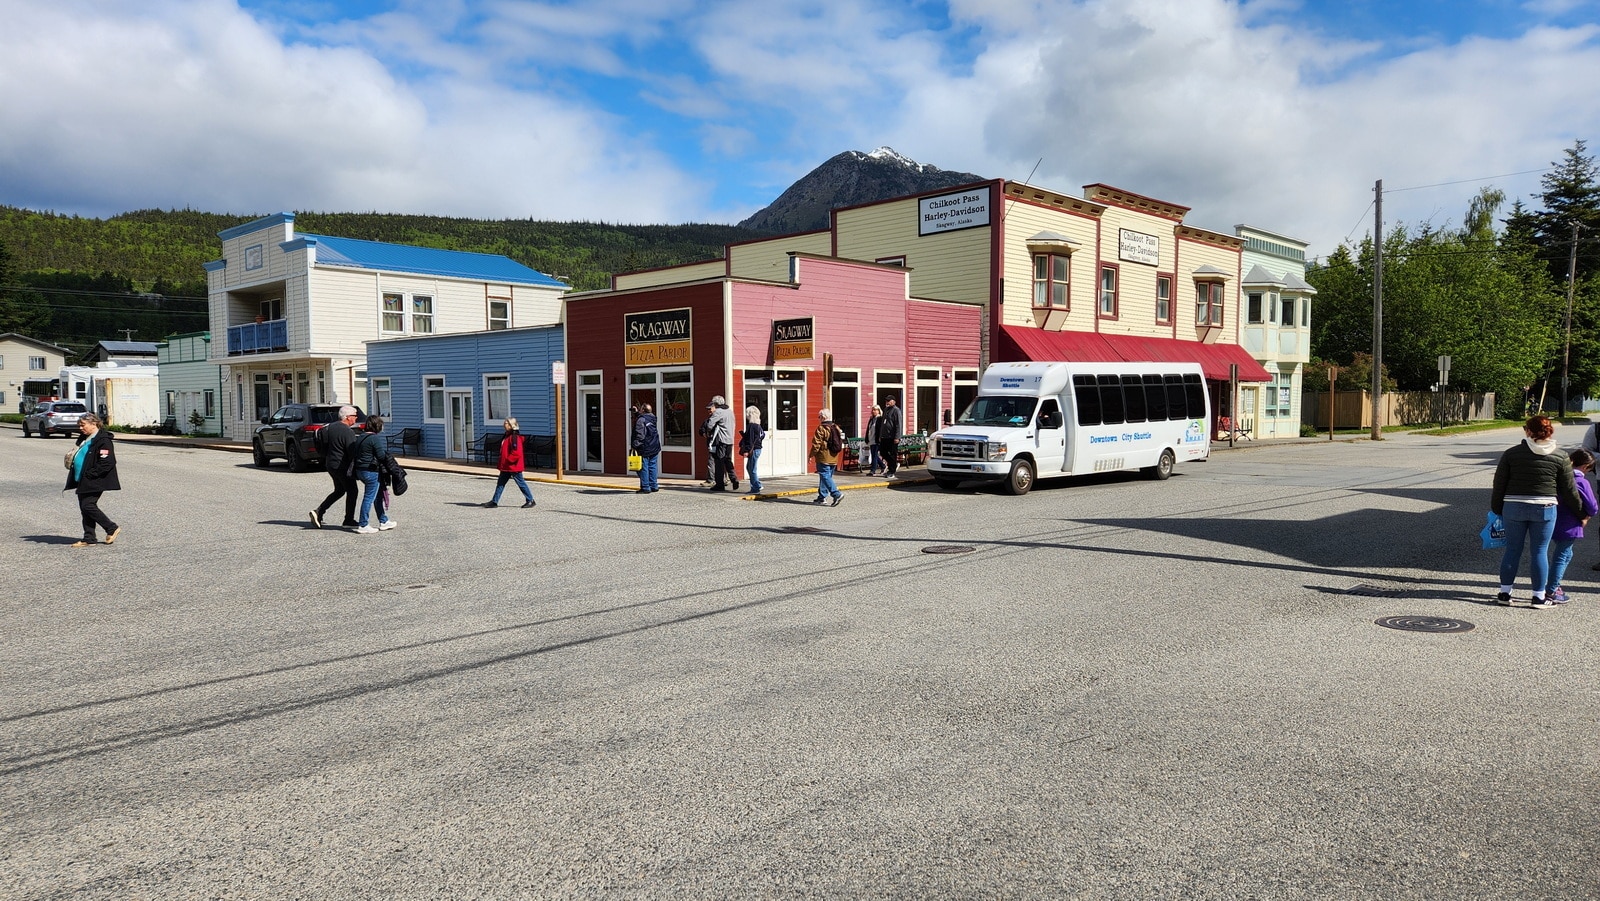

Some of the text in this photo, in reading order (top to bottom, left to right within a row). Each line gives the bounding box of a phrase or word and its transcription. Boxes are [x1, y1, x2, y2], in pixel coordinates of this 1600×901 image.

[929, 195, 980, 209] Chilkoot Pass
[924, 205, 985, 221] Harley-Davidson
[1124, 231, 1156, 246] Chilkoot Pass
[1120, 242, 1158, 257] Harley-Davidson
[1090, 432, 1152, 444] Downtown City Shuttle
